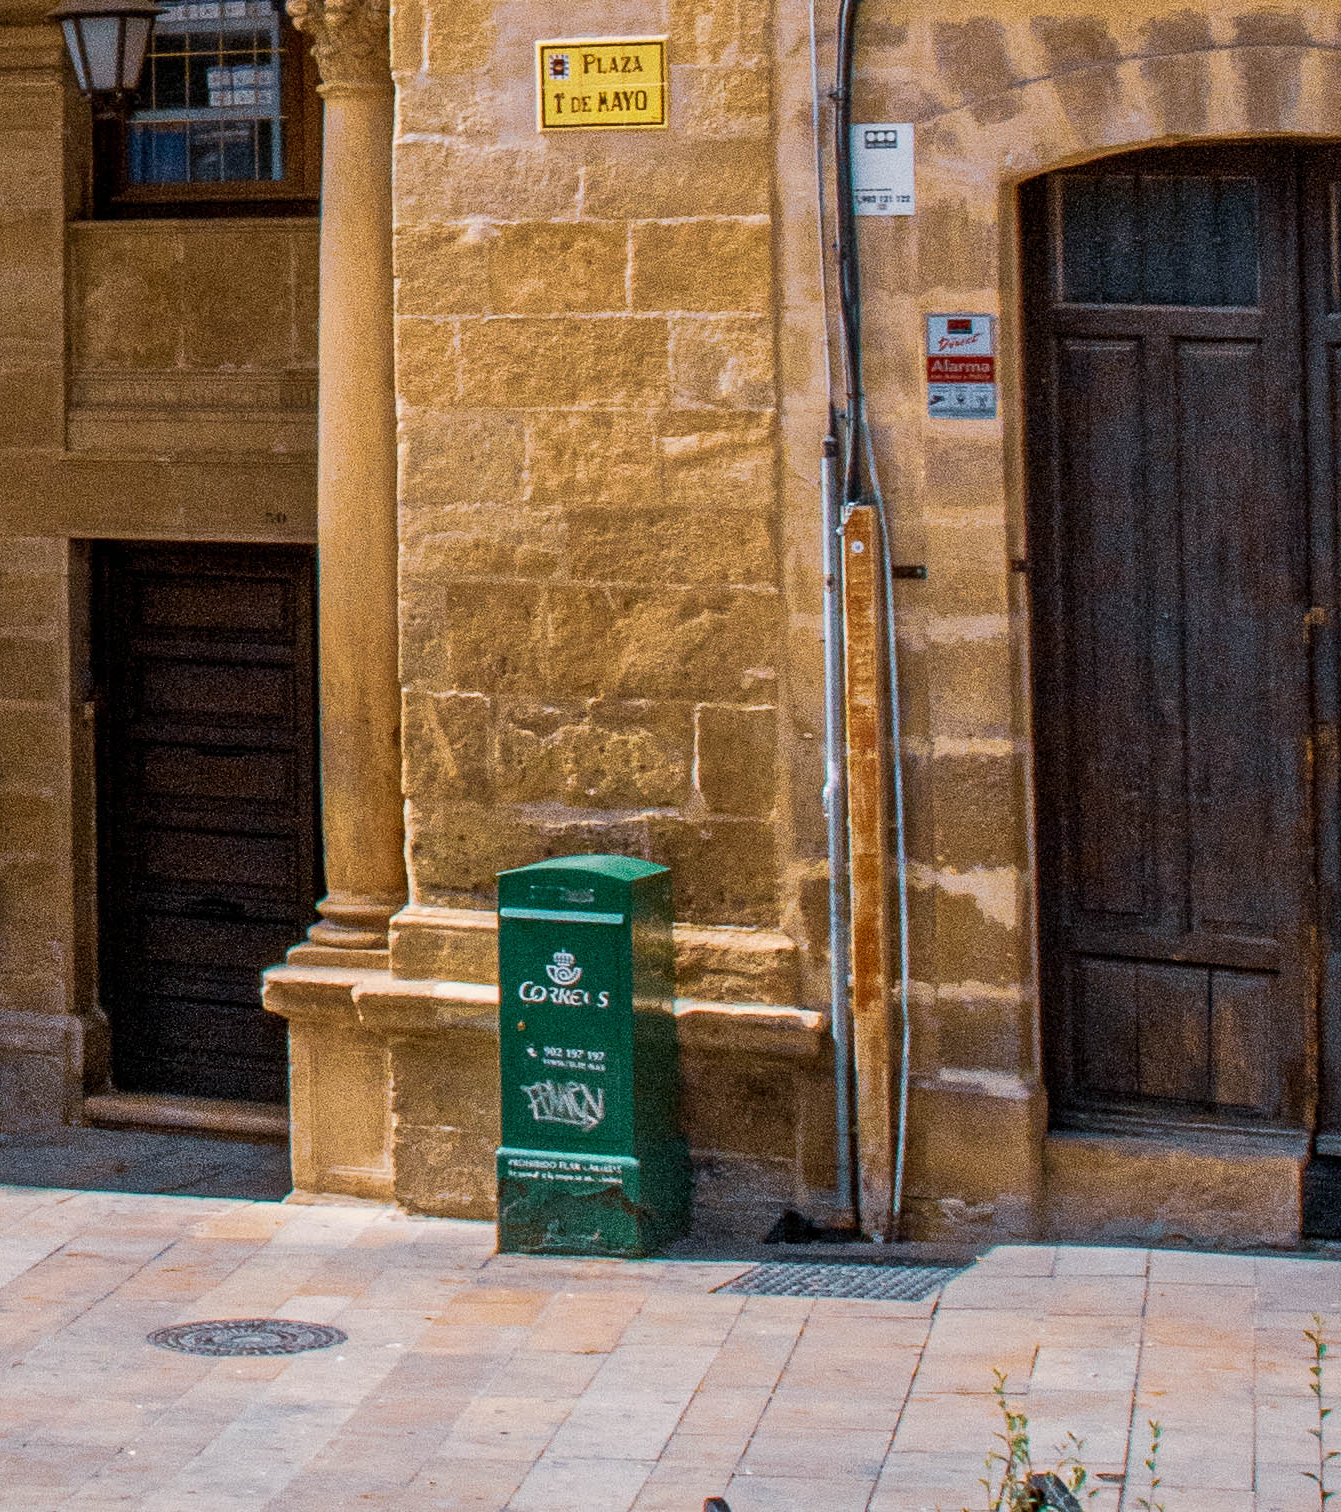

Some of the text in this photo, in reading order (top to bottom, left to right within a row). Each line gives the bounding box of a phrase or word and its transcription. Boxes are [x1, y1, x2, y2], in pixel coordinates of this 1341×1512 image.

[582, 53, 644, 74] PLAZA
[571, 96, 592, 113] DE
[598, 90, 648, 113] MAYO
[931, 359, 991, 373] Alarma
[543, 1046, 563, 1058] 902
